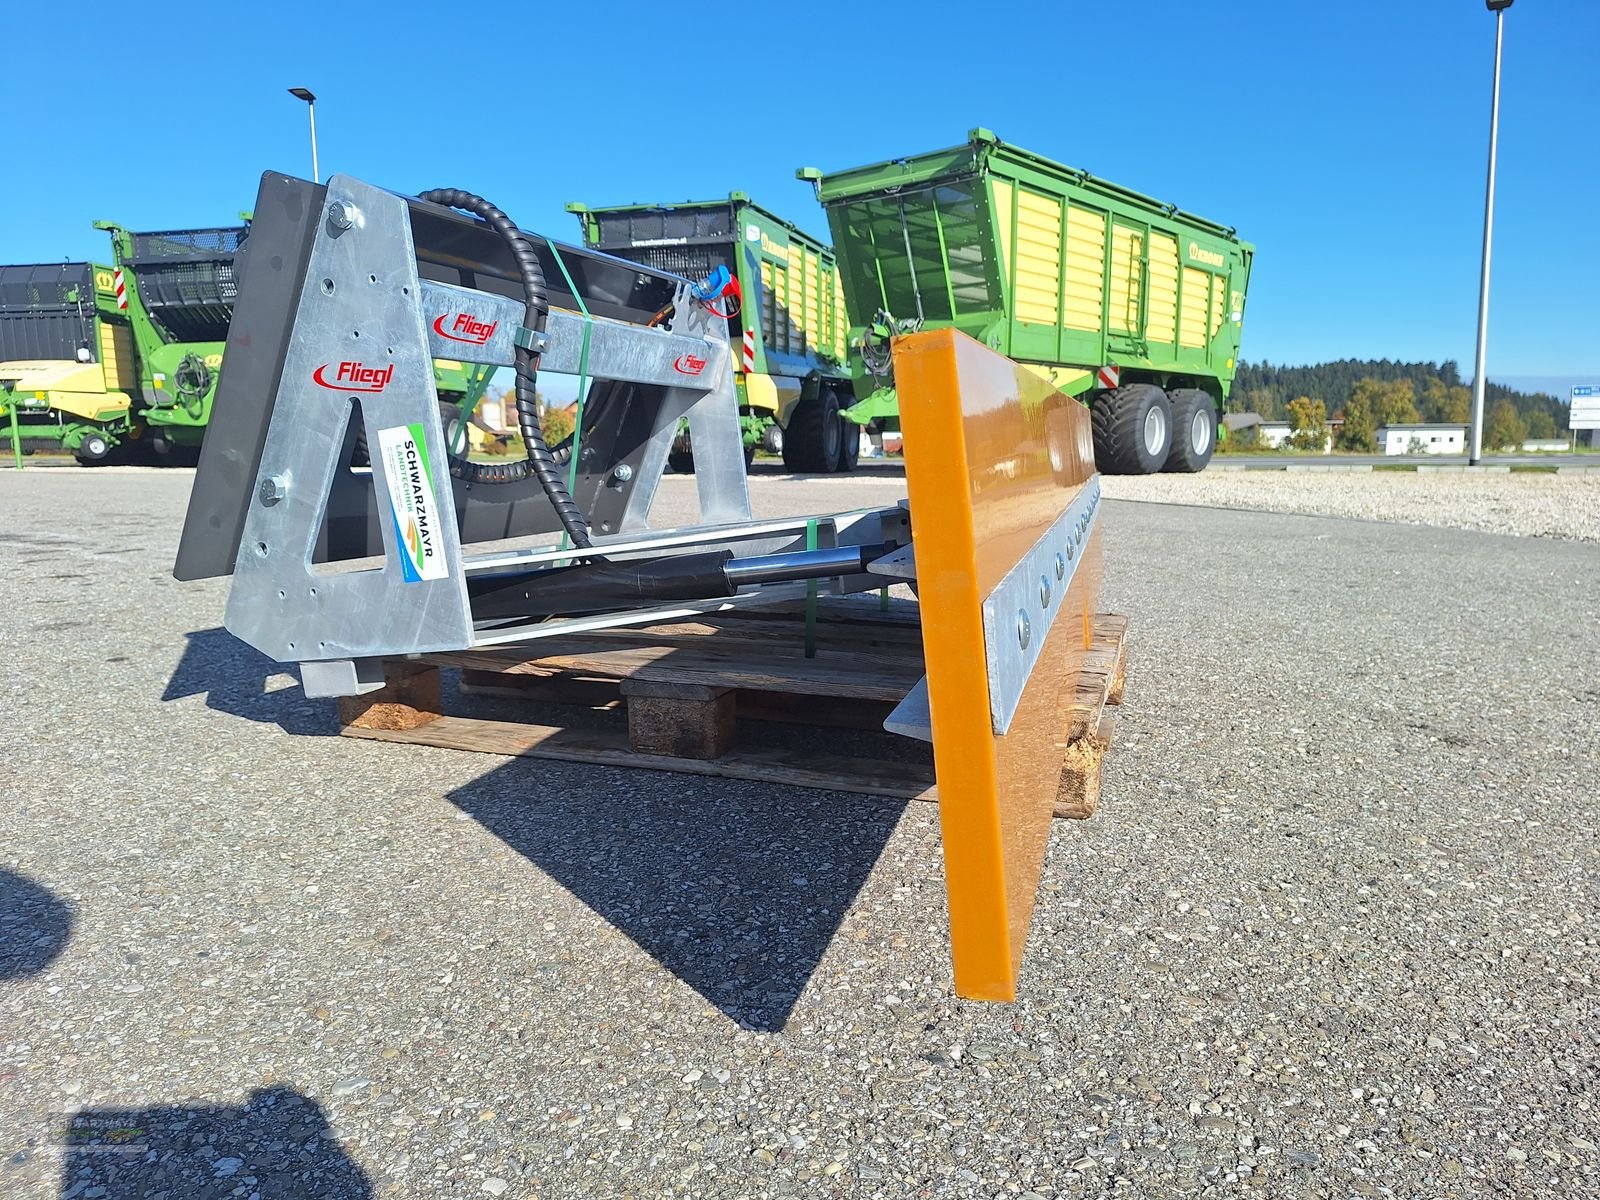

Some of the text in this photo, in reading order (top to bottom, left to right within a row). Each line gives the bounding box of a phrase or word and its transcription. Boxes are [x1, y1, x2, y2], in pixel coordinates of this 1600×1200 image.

[1197, 248, 1224, 267] KRONE
[452, 313, 498, 341] Fliegl
[336, 361, 394, 388] Fliegl
[684, 354, 708, 373] Fliegl
[395, 444, 414, 513] LANDTECHNIK
[404, 440, 433, 557] SCHWARZMAYR
